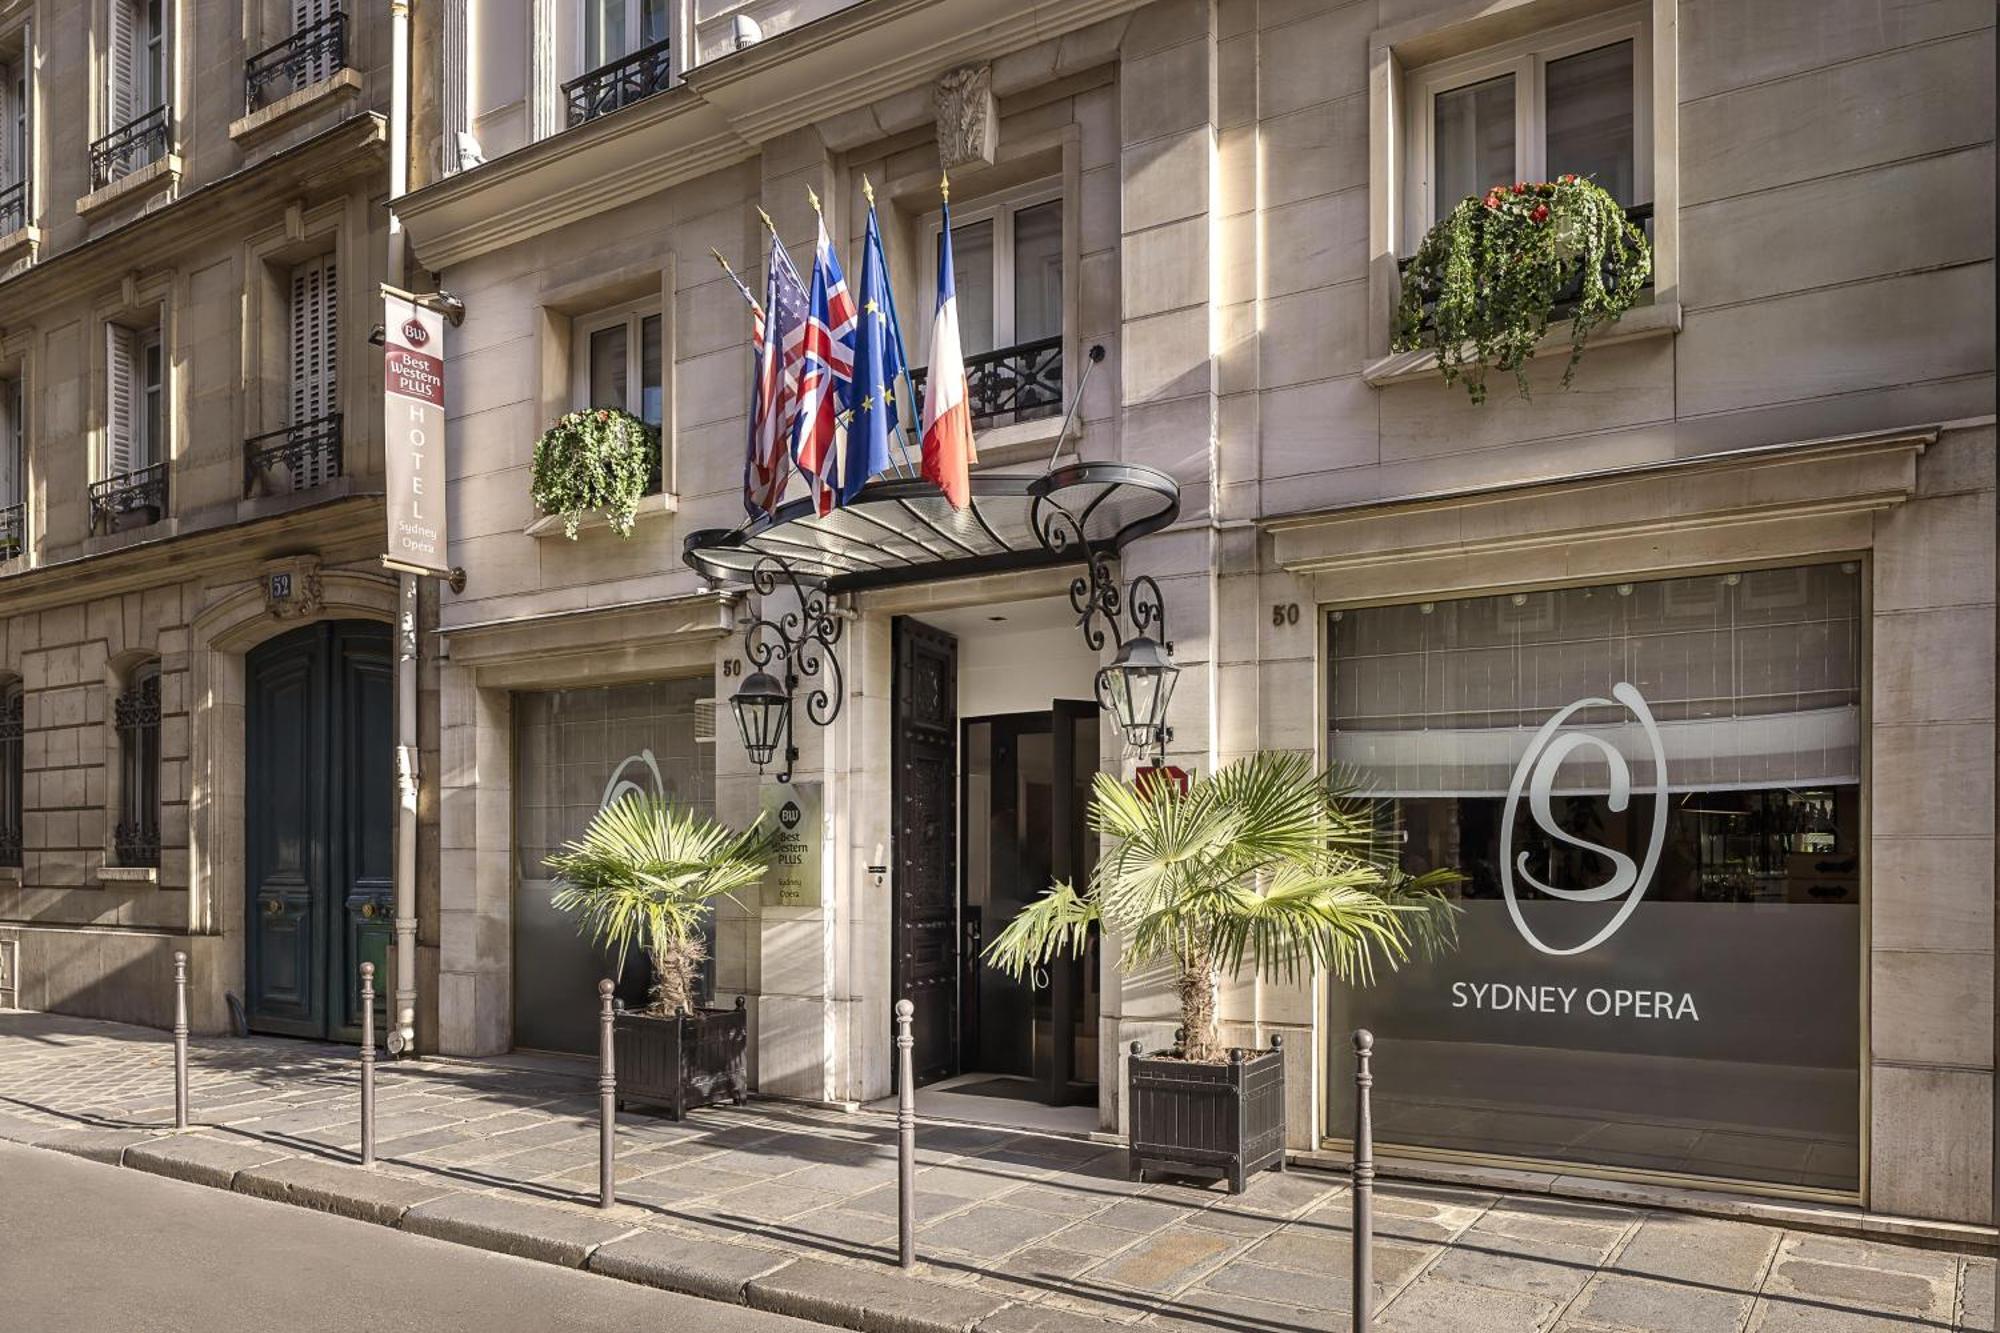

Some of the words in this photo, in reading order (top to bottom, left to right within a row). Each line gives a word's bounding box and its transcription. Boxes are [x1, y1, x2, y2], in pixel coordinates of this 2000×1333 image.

[404, 325, 426, 341] BW
[403, 353, 430, 371] Best
[391, 360, 440, 386] Western
[400, 377, 432, 396] PLUS
[409, 404, 426, 519] HOTEL
[400, 520, 437, 540] Sydney
[274, 575, 289, 597] 52
[1272, 603, 1300, 626] 50
[723, 659, 741, 677] 50
[782, 809, 799, 822] BW
[780, 831, 800, 842] Best
[778, 854, 802, 865] PLUS
[1452, 982, 1577, 1014] SYDNEY
[1586, 988, 1699, 1021] OPERA
